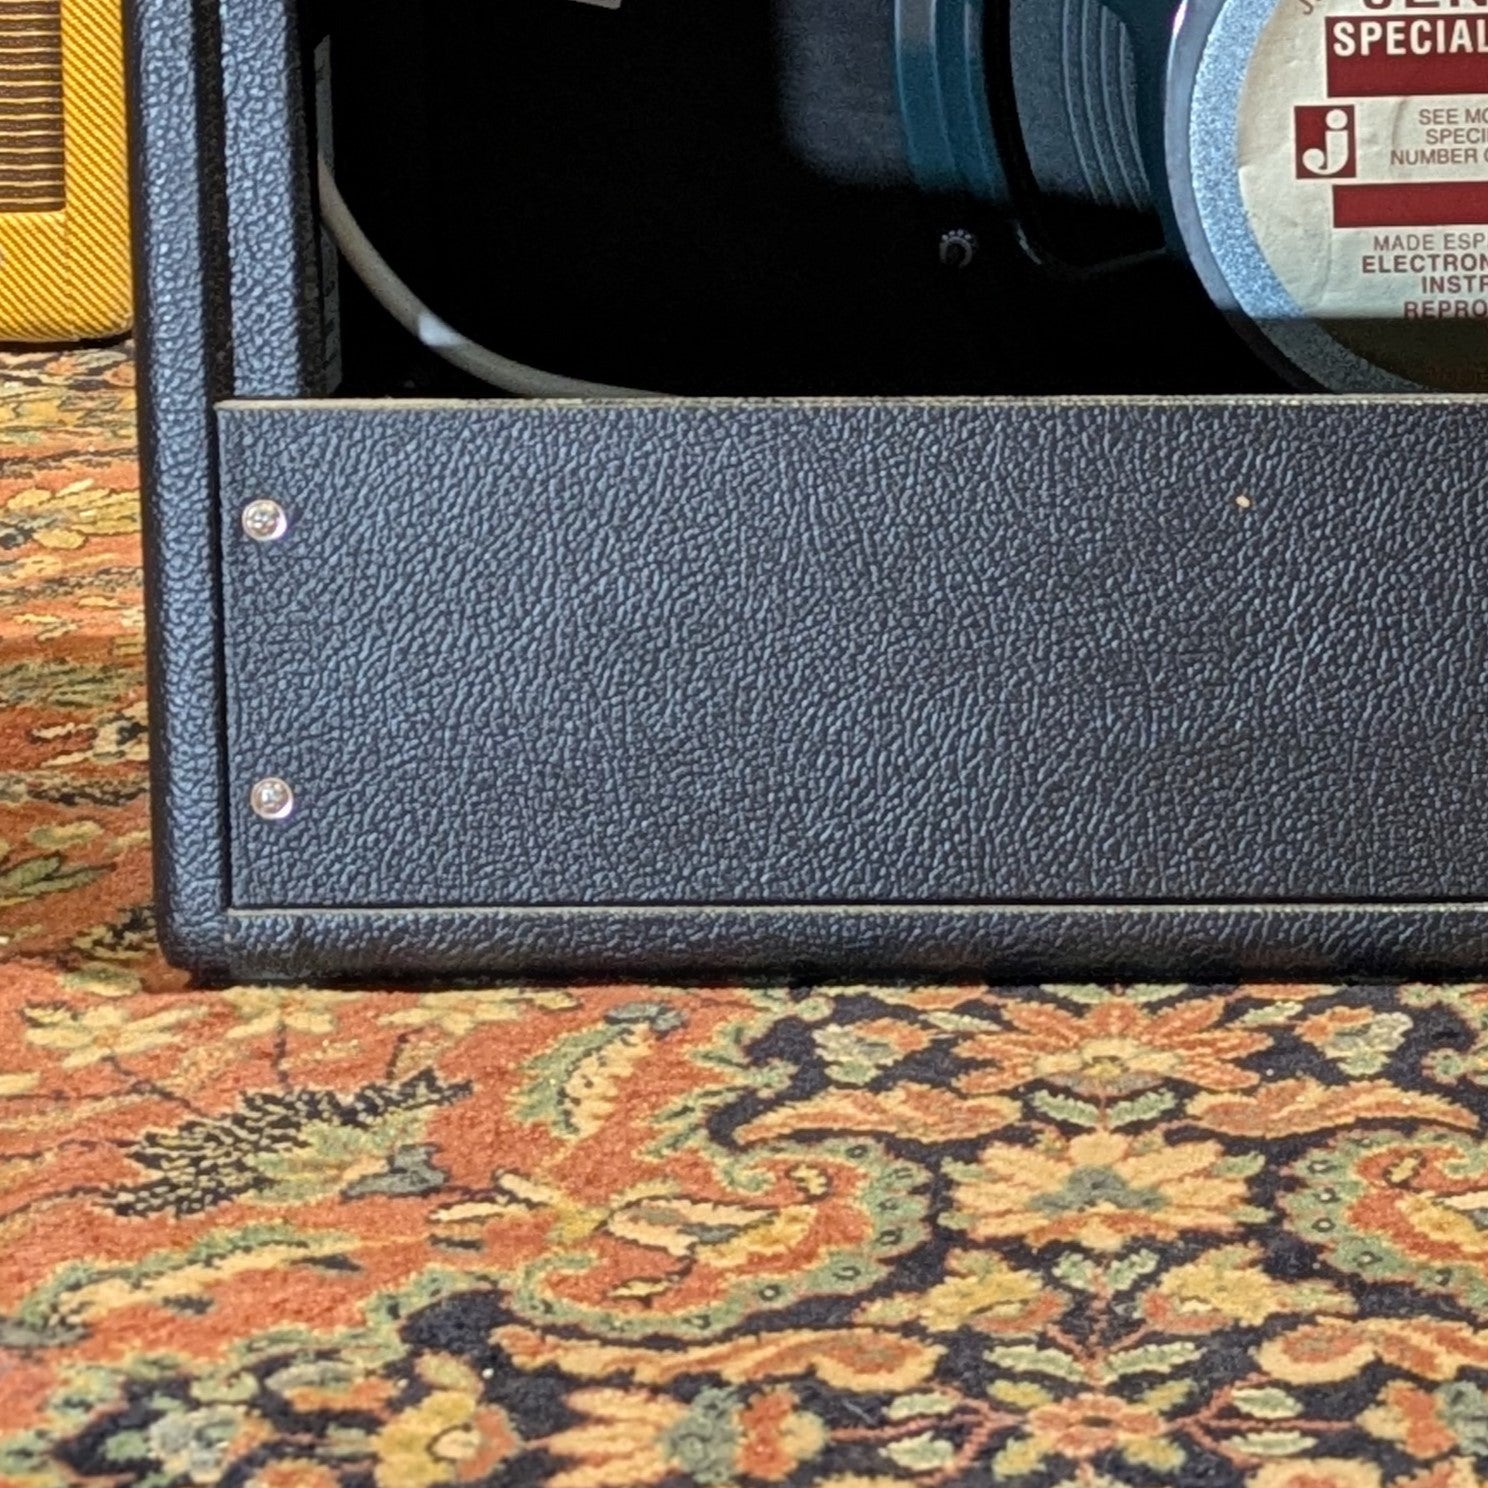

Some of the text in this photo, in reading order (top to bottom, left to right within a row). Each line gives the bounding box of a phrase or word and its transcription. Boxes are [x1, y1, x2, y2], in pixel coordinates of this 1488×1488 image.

[1418, 108, 1460, 125] SEE
[1390, 148, 1478, 166] NUMBER
[1374, 233, 1434, 251] MADE
